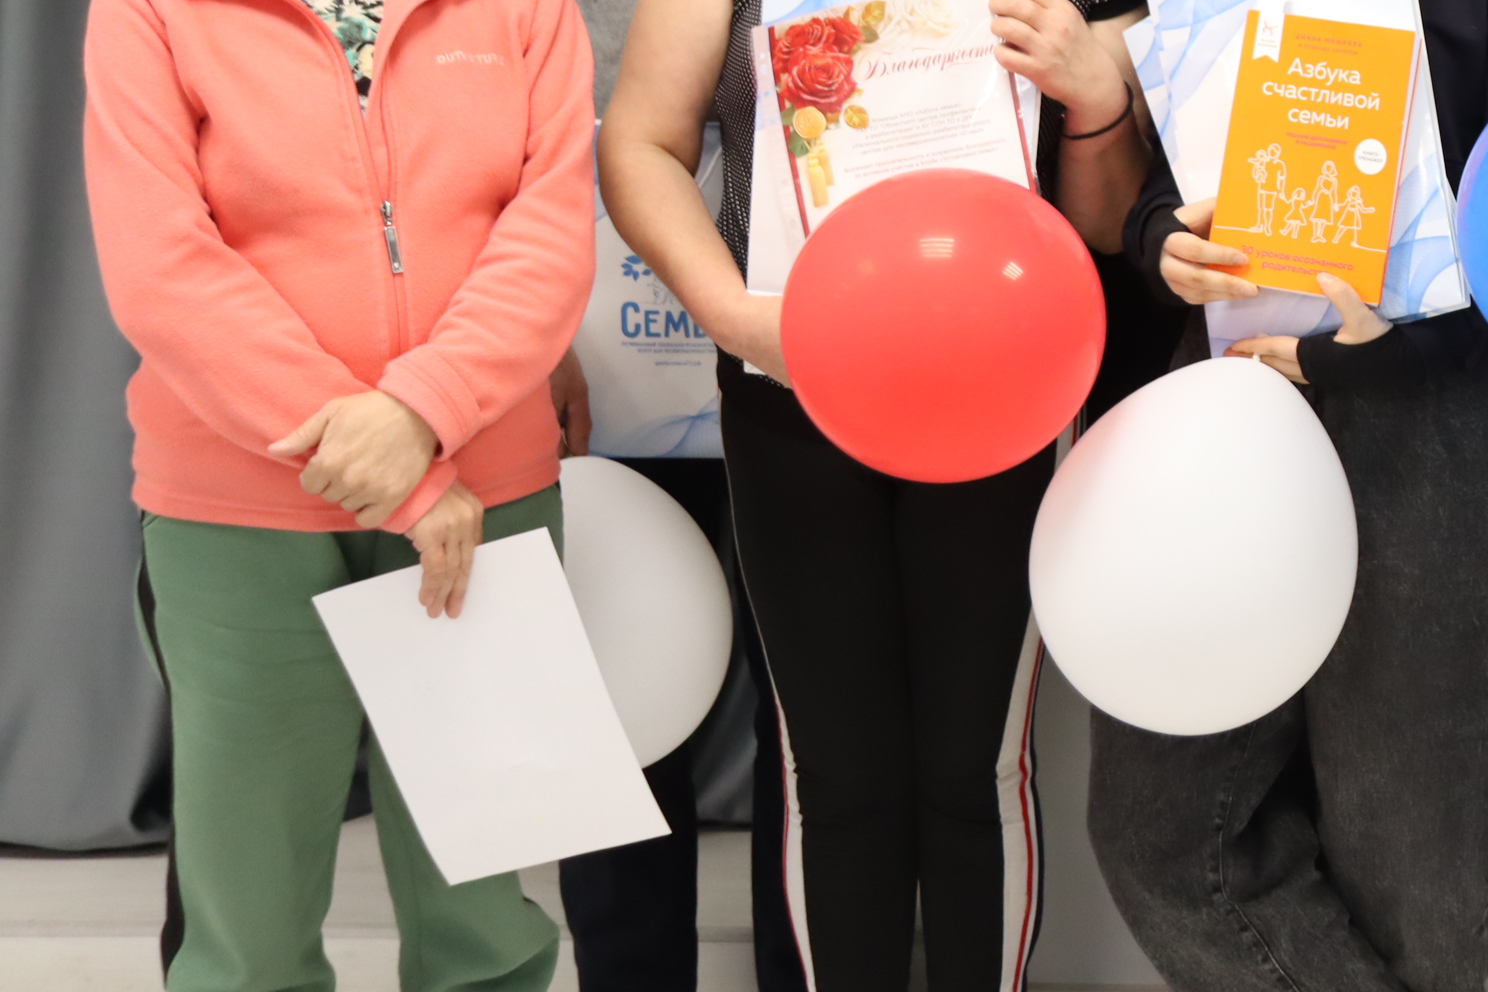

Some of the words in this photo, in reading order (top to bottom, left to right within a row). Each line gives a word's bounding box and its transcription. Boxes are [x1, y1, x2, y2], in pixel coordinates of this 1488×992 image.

[1287, 57, 1361, 85] Азбука
[1262, 81, 1380, 111] счастливой
[1288, 107, 1350, 129] семьи
[1257, 251, 1291, 262] уроков
[1262, 262, 1329, 277] родительст
[621, 301, 708, 338] СЕМ
